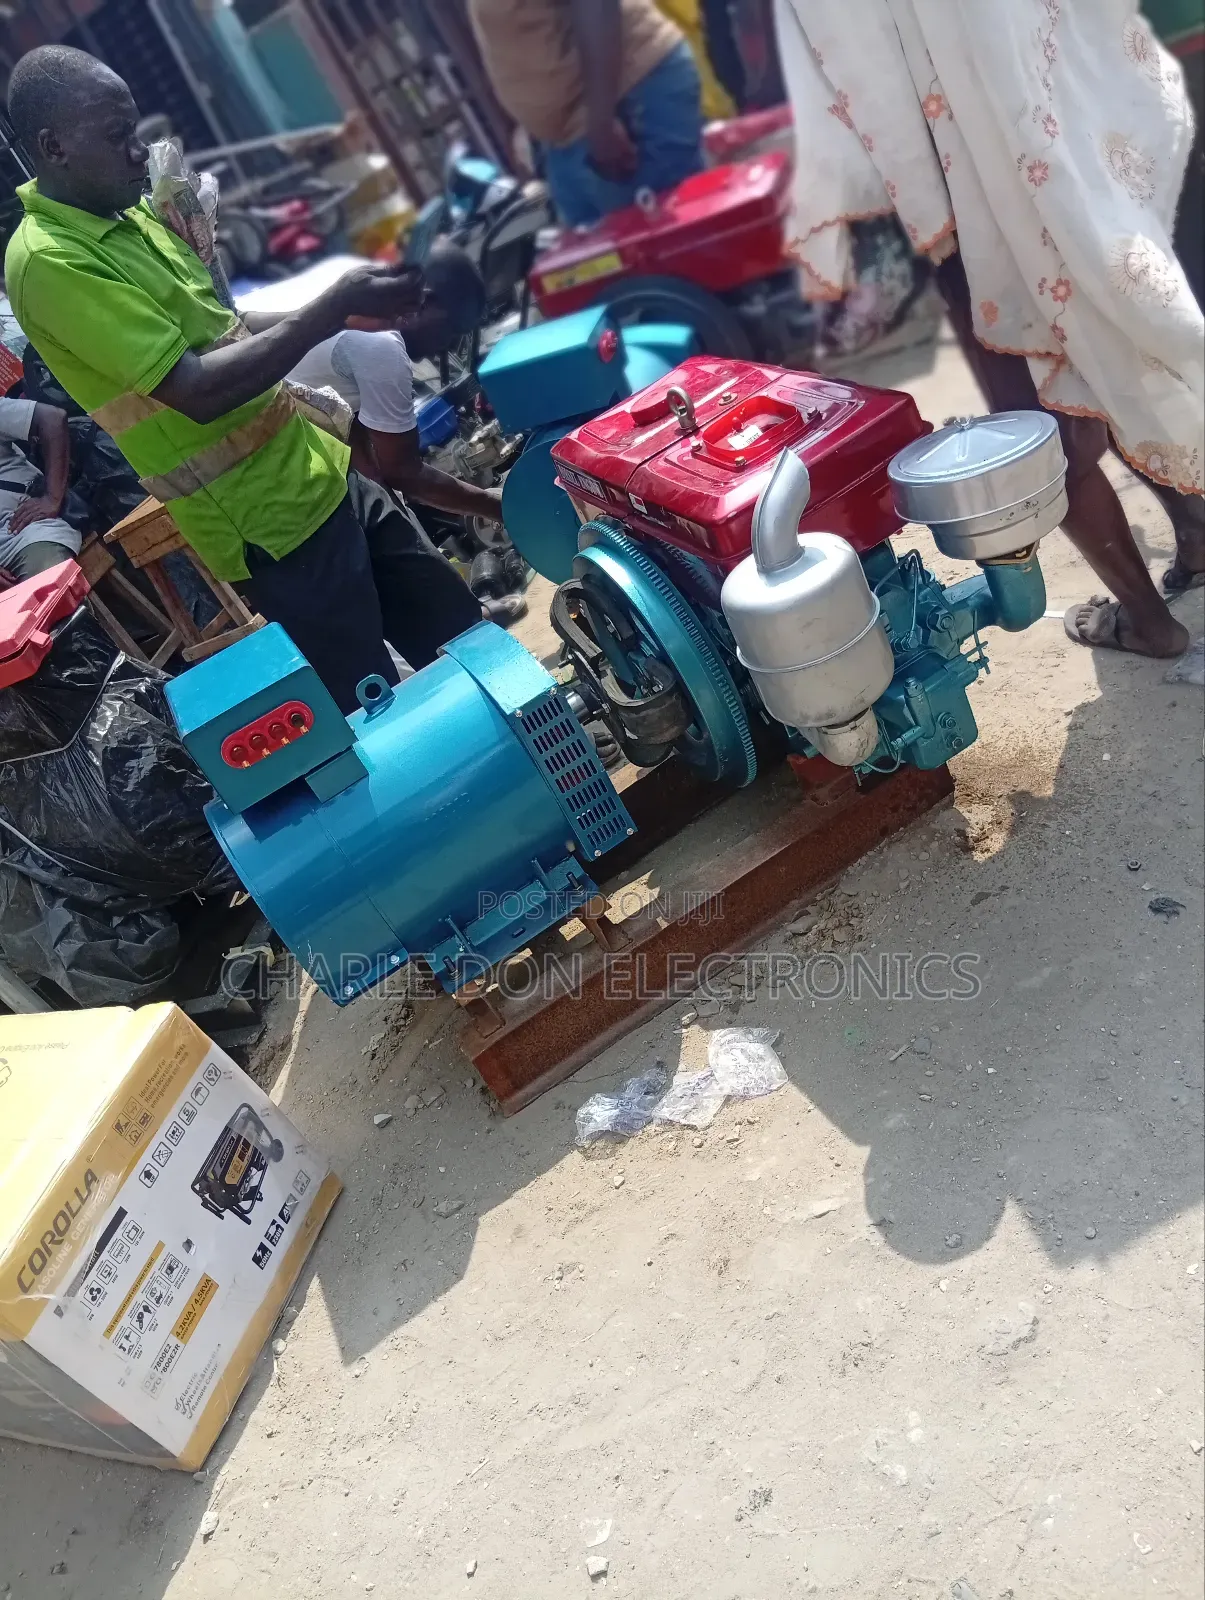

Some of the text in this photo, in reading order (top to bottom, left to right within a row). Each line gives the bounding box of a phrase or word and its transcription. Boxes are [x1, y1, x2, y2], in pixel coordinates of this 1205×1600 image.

[17, 1168, 100, 1293] COROLLA
[174, 1309, 193, 1338] 4.2KVA
[192, 1277, 212, 1305] 4.5KVA
[152, 1342, 172, 1372] 7800E2
